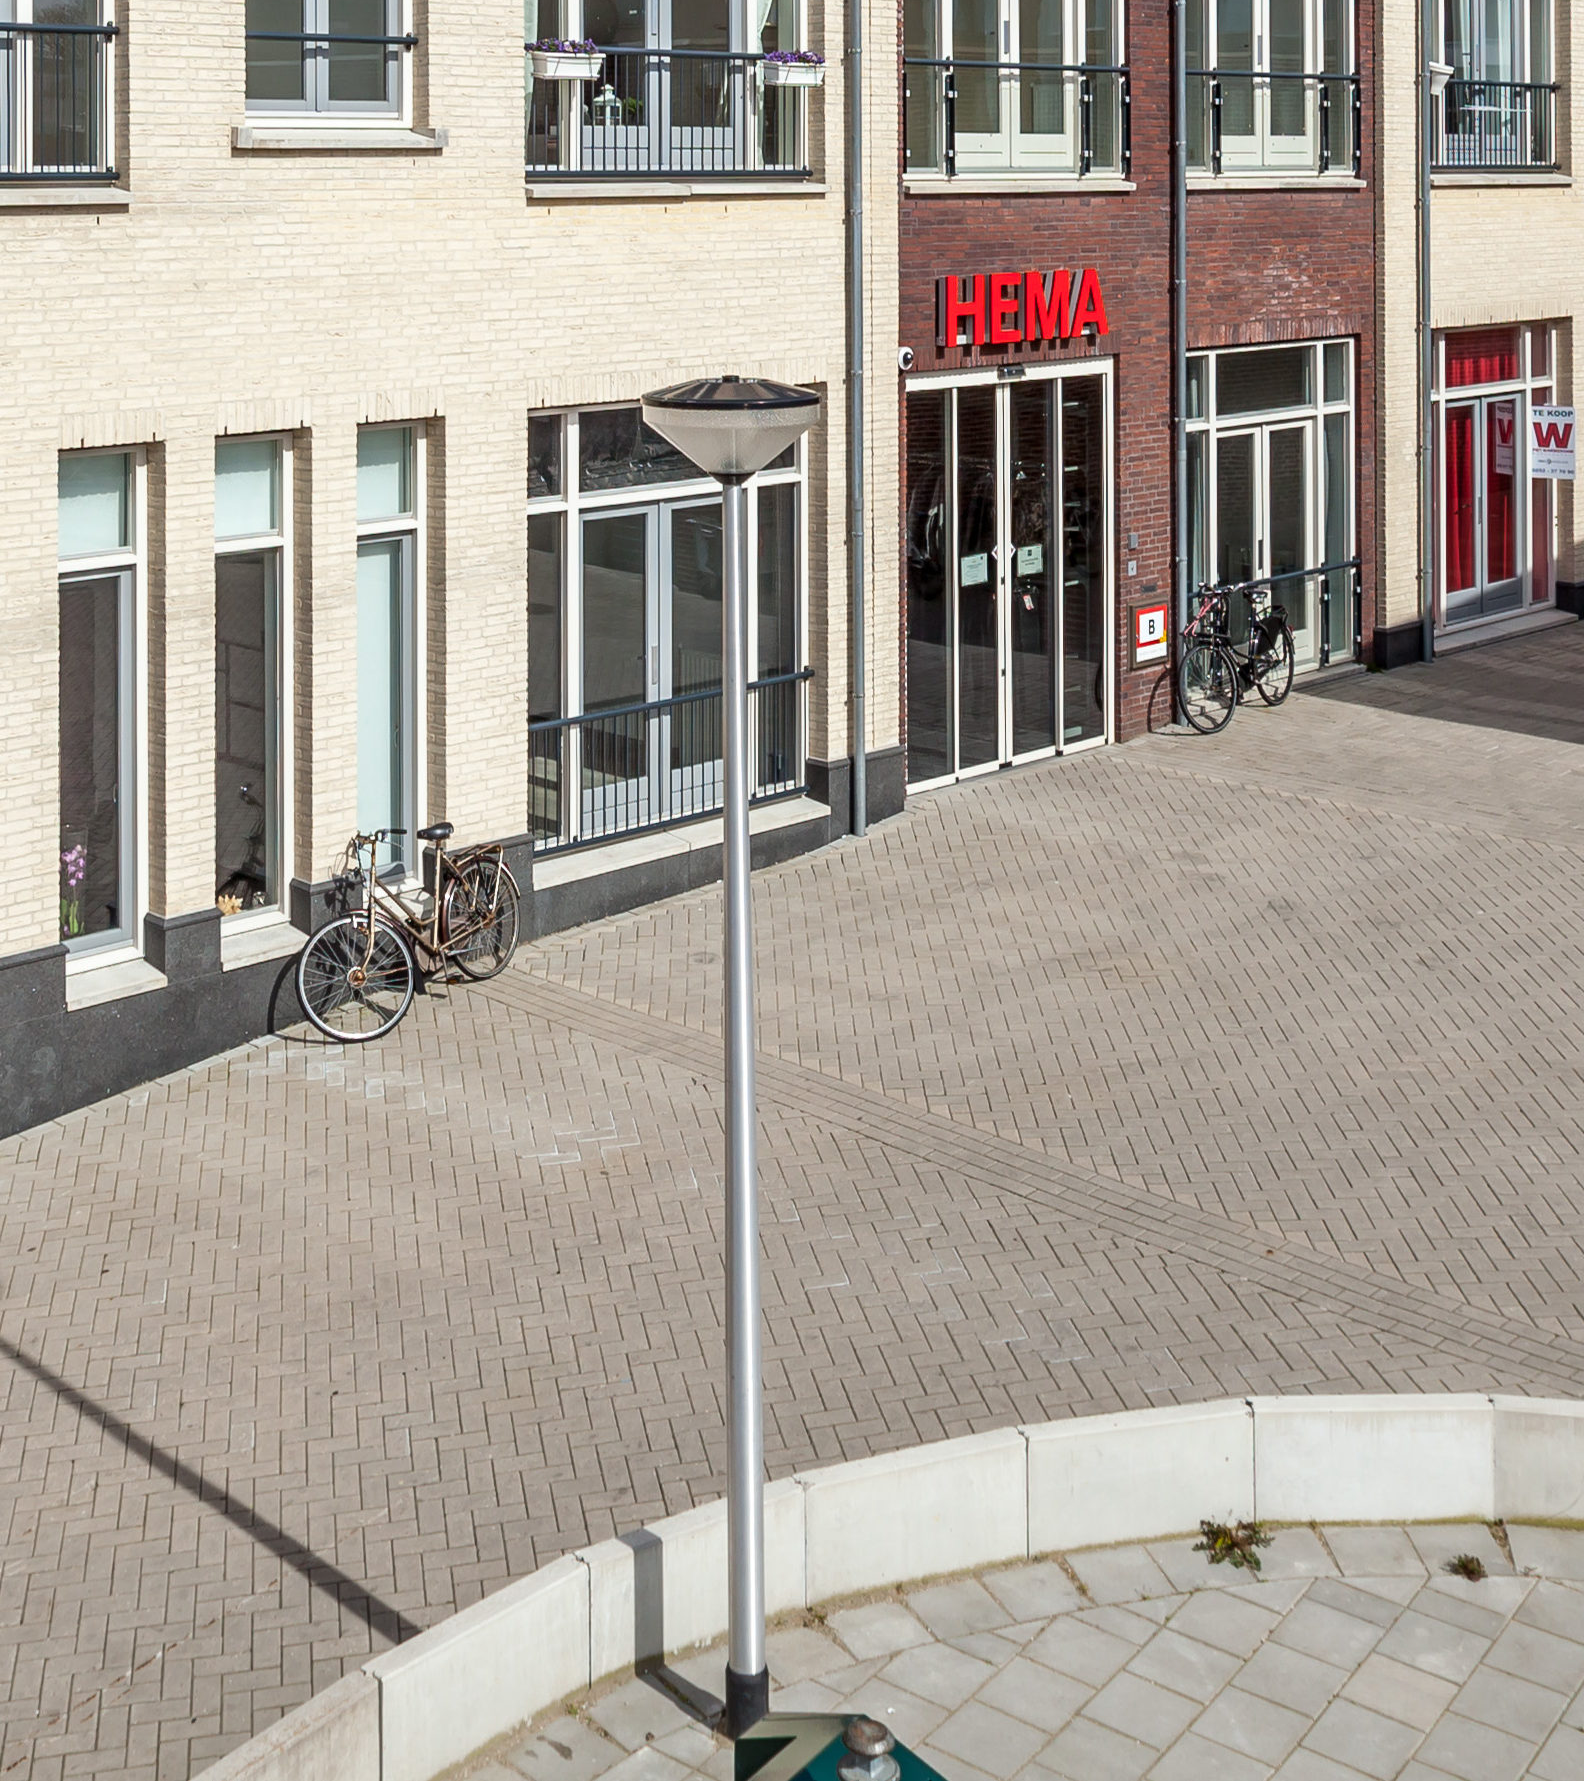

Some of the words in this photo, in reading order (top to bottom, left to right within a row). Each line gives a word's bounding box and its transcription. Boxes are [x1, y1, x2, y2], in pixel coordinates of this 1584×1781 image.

[944, 267, 1110, 348] HEMA
[1532, 422, 1573, 449] W
[1148, 619, 1155, 635] B
